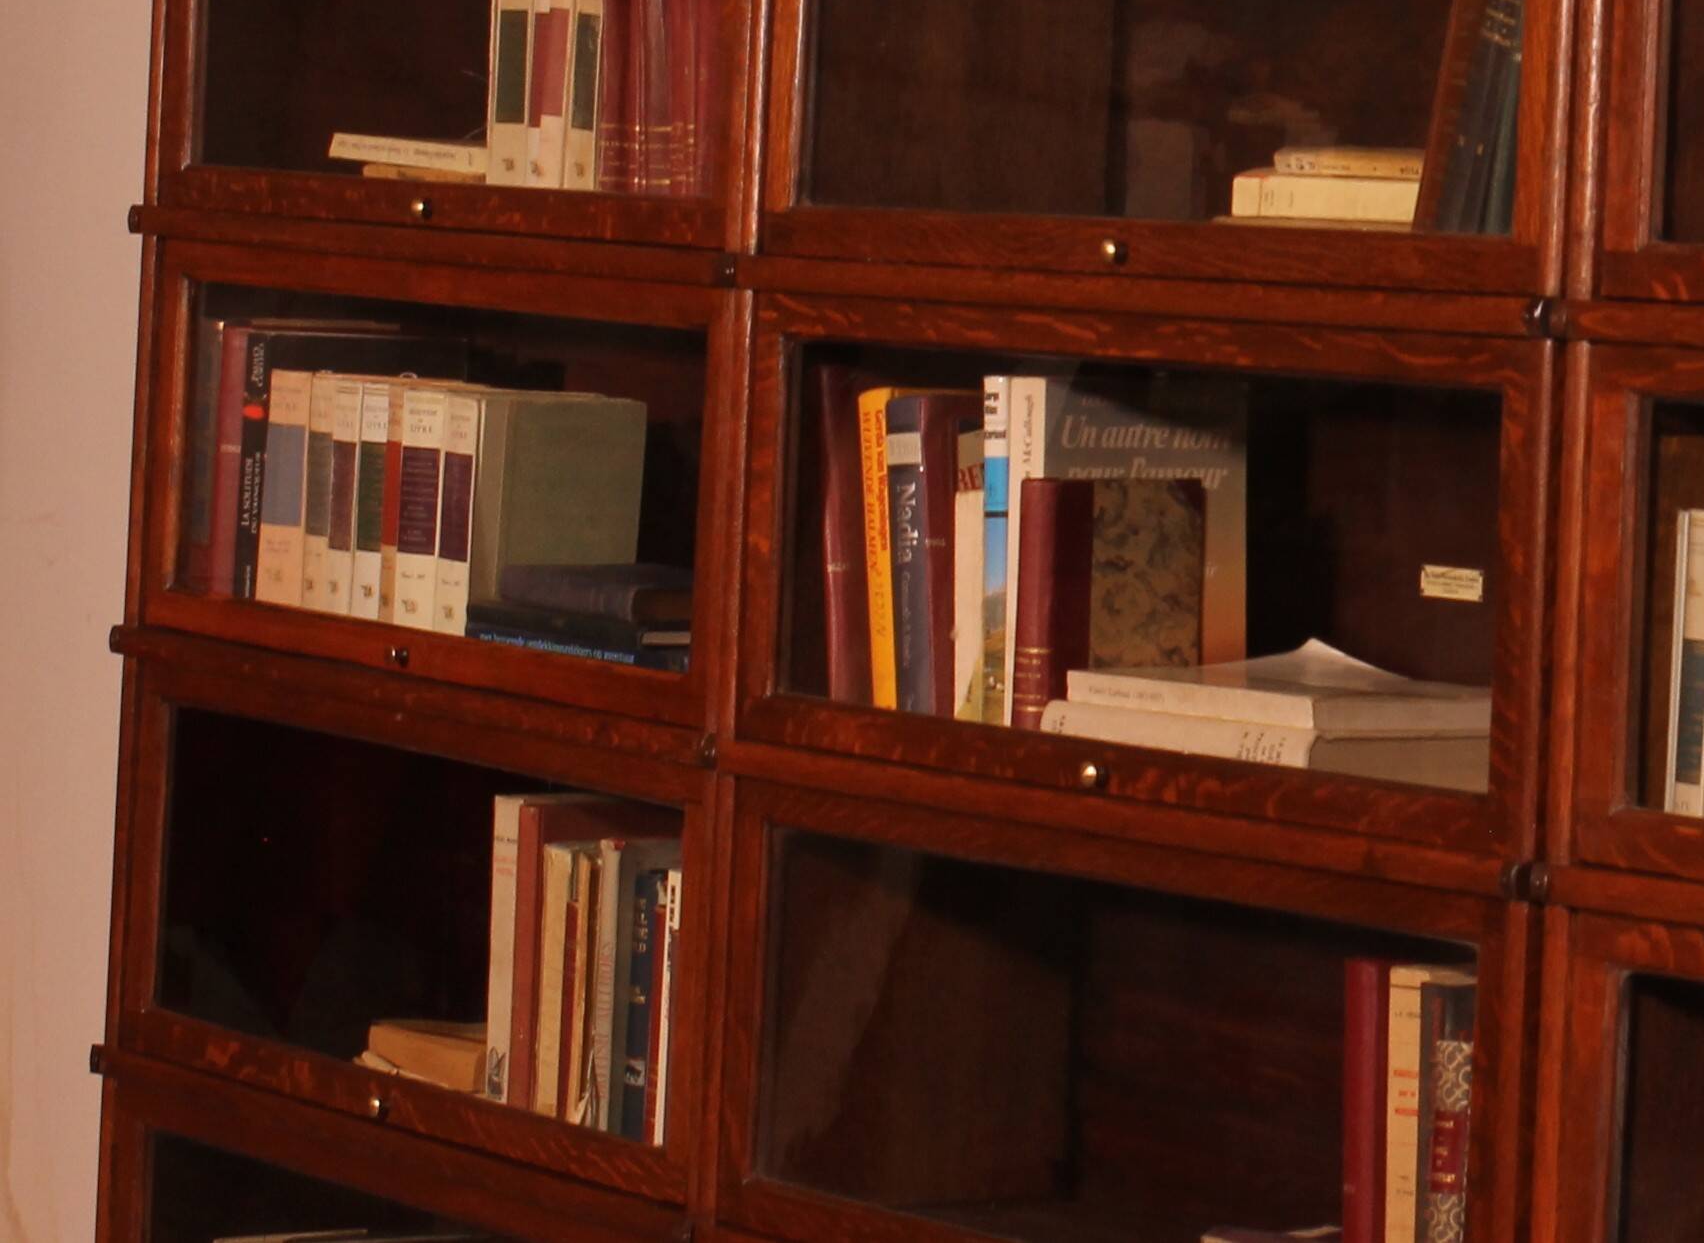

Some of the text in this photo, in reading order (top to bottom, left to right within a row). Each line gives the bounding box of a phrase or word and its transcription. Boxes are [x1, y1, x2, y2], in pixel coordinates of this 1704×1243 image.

[1060, 414, 1098, 449] Un
[1101, 423, 1172, 449] autre
[895, 481, 920, 565] Nadia
